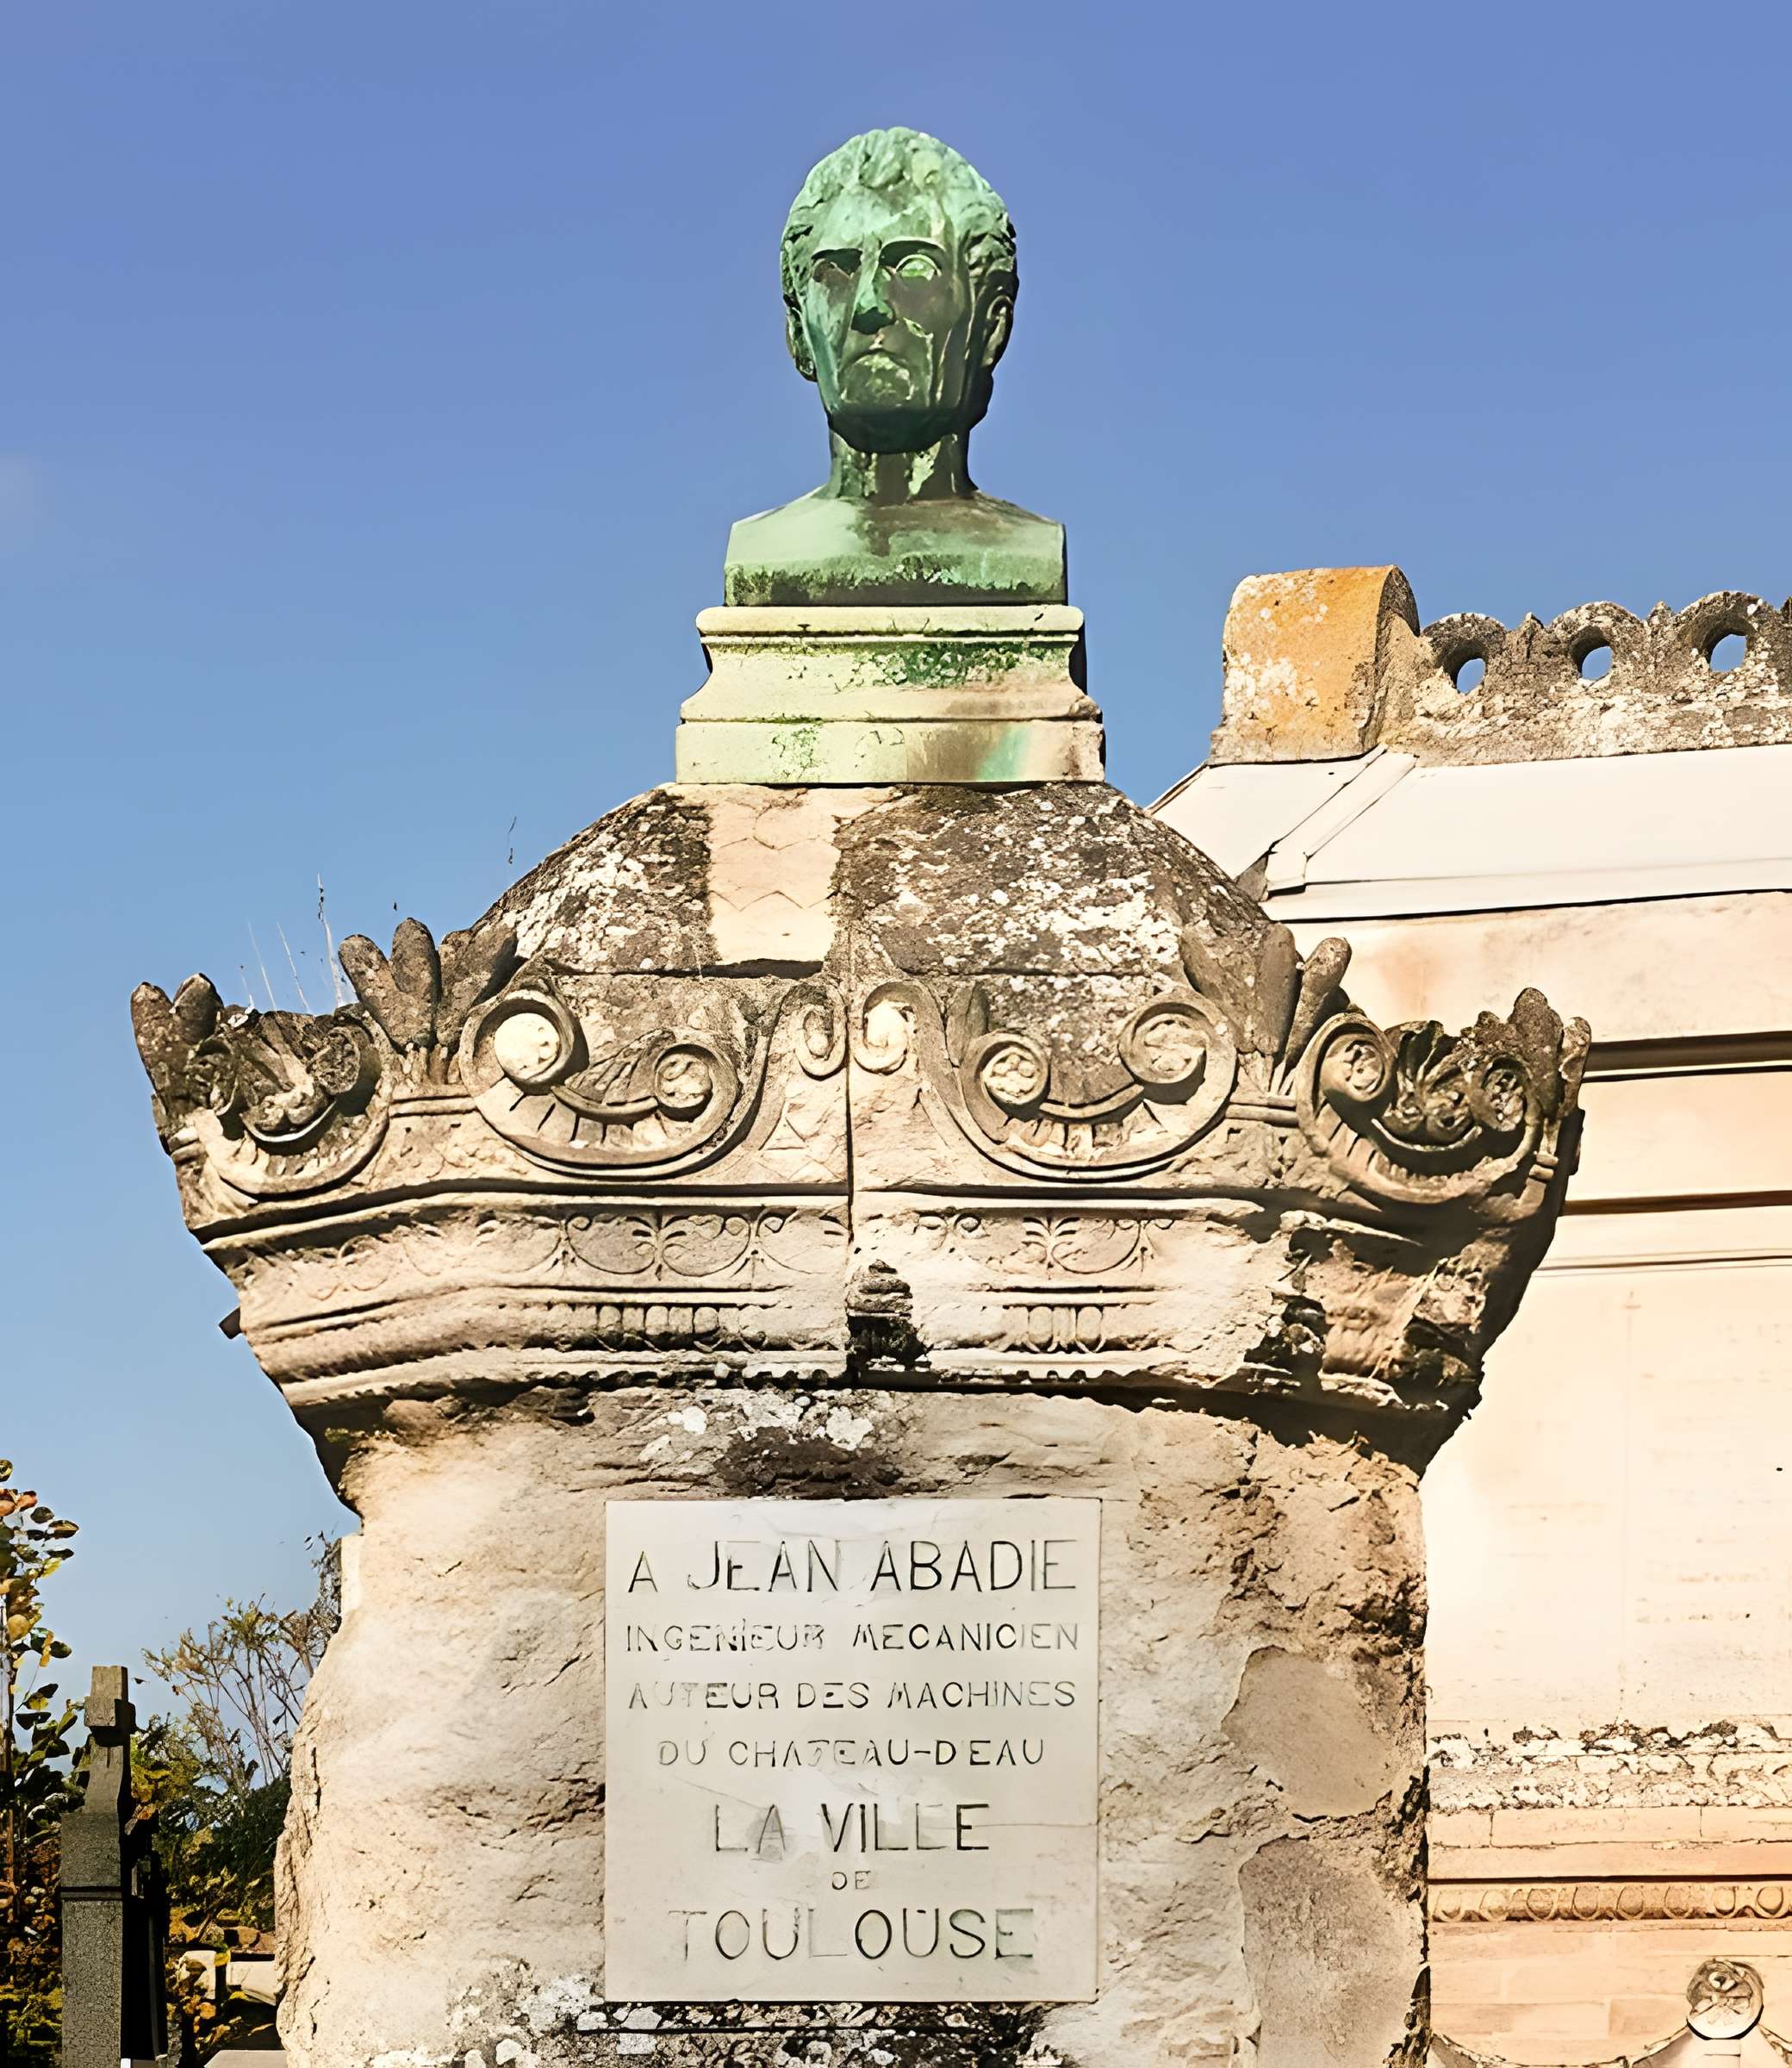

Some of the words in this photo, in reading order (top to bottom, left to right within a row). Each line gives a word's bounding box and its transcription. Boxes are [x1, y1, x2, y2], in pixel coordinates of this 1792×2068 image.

[627, 1551, 659, 1593] A
[687, 1538, 841, 1593] JEAN
[869, 1538, 1077, 1592] ABADIE
[626, 1617, 825, 1652] INGENIEUR
[852, 1623, 1078, 1651] MECANICIEN
[628, 1680, 780, 1710] AUTEUR
[797, 1681, 869, 1710] DES
[887, 1680, 1076, 1710] MACHINES
[657, 1739, 710, 1766] DU
[714, 1803, 787, 1853] LA
[820, 1803, 990, 1852] VILLE
[831, 1870, 872, 1891] DE
[668, 1907, 1035, 1960] TOULOUSE
